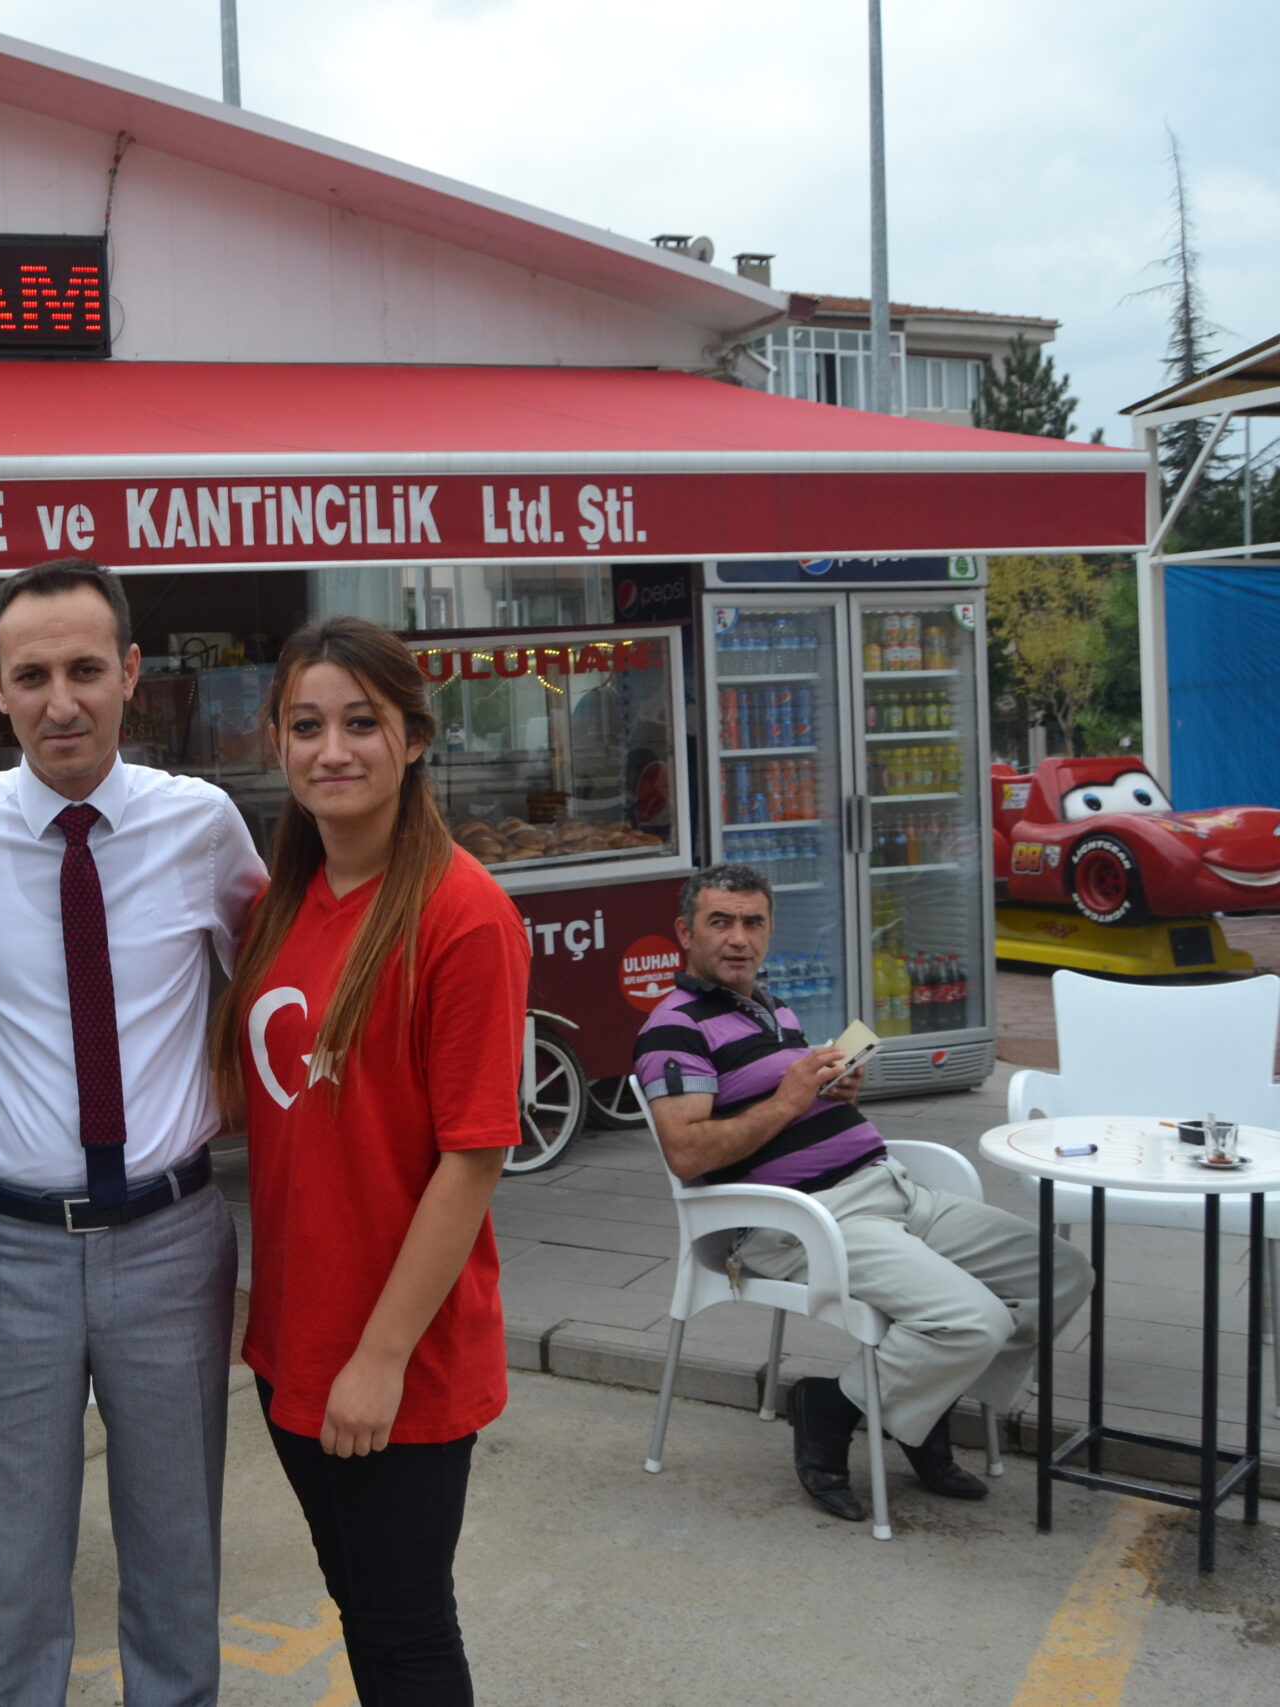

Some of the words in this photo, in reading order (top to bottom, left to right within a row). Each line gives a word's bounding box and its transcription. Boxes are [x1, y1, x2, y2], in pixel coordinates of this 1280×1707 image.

[37, 503, 95, 551] ve
[482, 485, 564, 543] Ltd.
[577, 484, 648, 549] Şti.
[641, 577, 685, 608] pepsi
[417, 640, 650, 684] ULUHAN
[623, 952, 680, 973] ULUHAN
